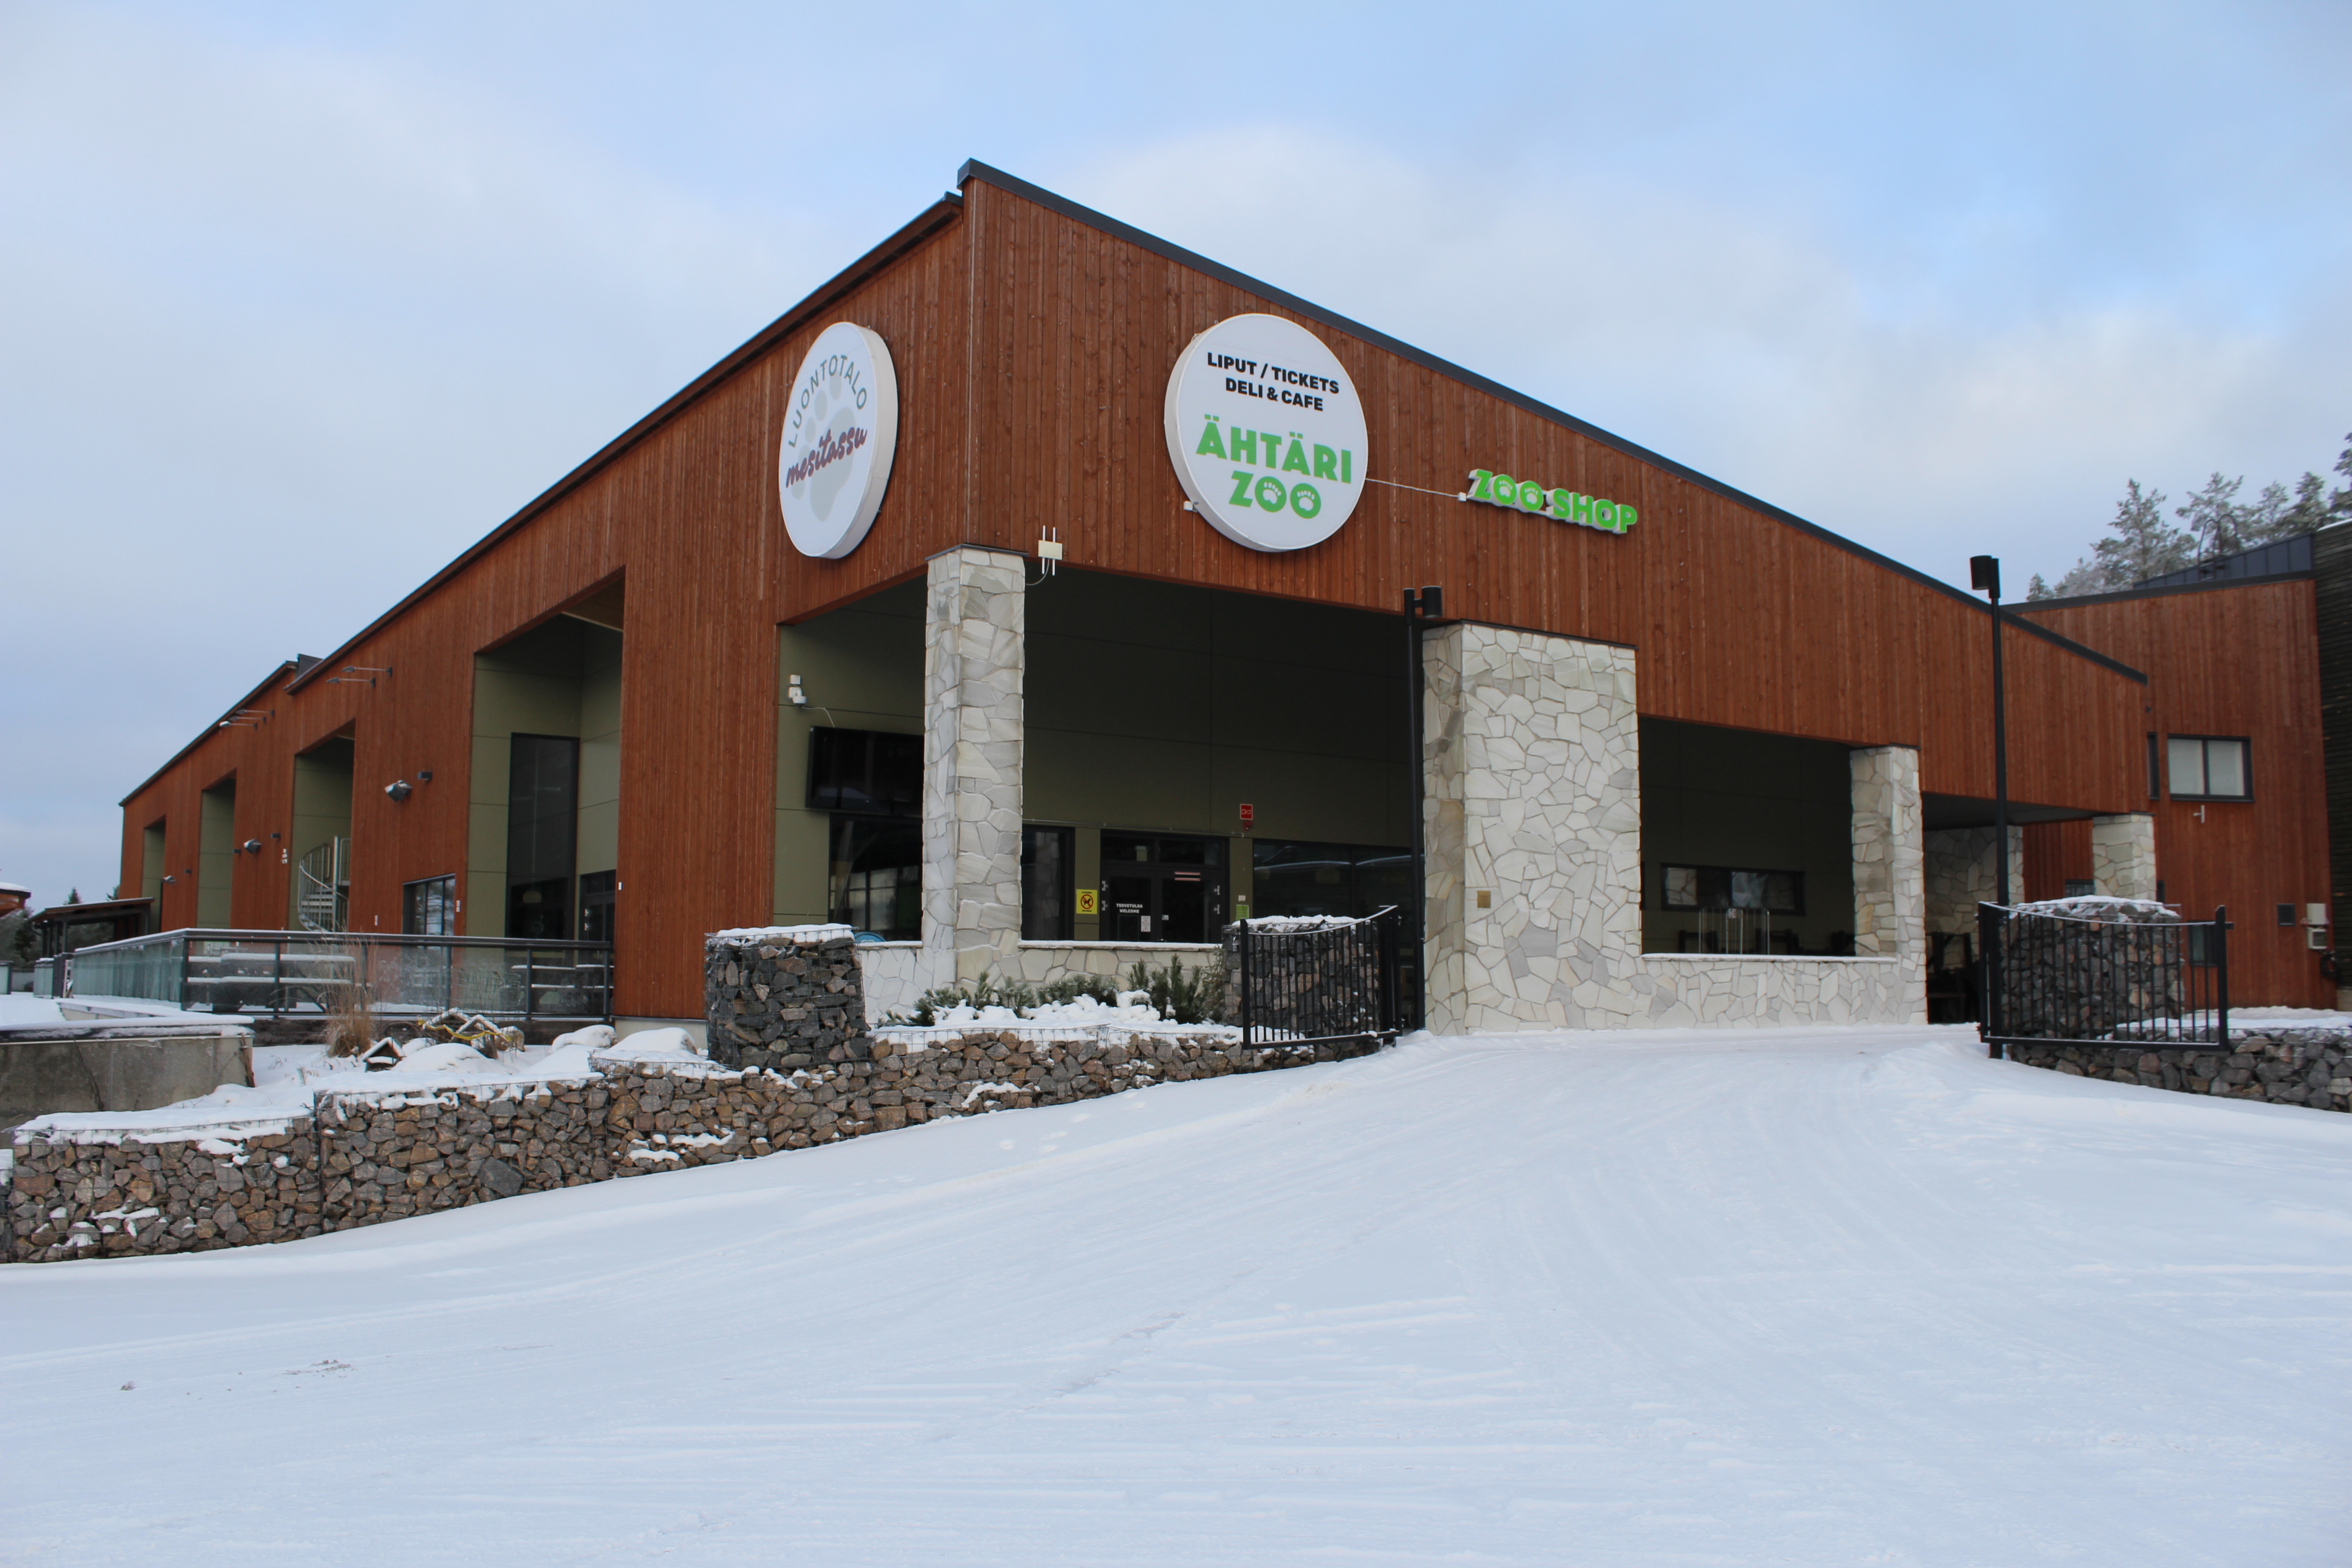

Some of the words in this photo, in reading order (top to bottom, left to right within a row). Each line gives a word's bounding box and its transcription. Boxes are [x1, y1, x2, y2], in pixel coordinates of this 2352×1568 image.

[1207, 352, 1257, 375] LIPUT
[1260, 363, 1268, 378] /
[1271, 367, 1339, 394] TICKETS
[1226, 378, 1263, 398] DELI
[1267, 387, 1278, 402] &
[1282, 390, 1323, 411] CAFE
[789, 355, 867, 448] LUONTOTALO
[1196, 414, 1352, 484] ÄHTÄRI
[1229, 470, 1321, 519] ZOO
[1467, 469, 1544, 512] ZOO
[1546, 488, 1637, 533] SHOP
